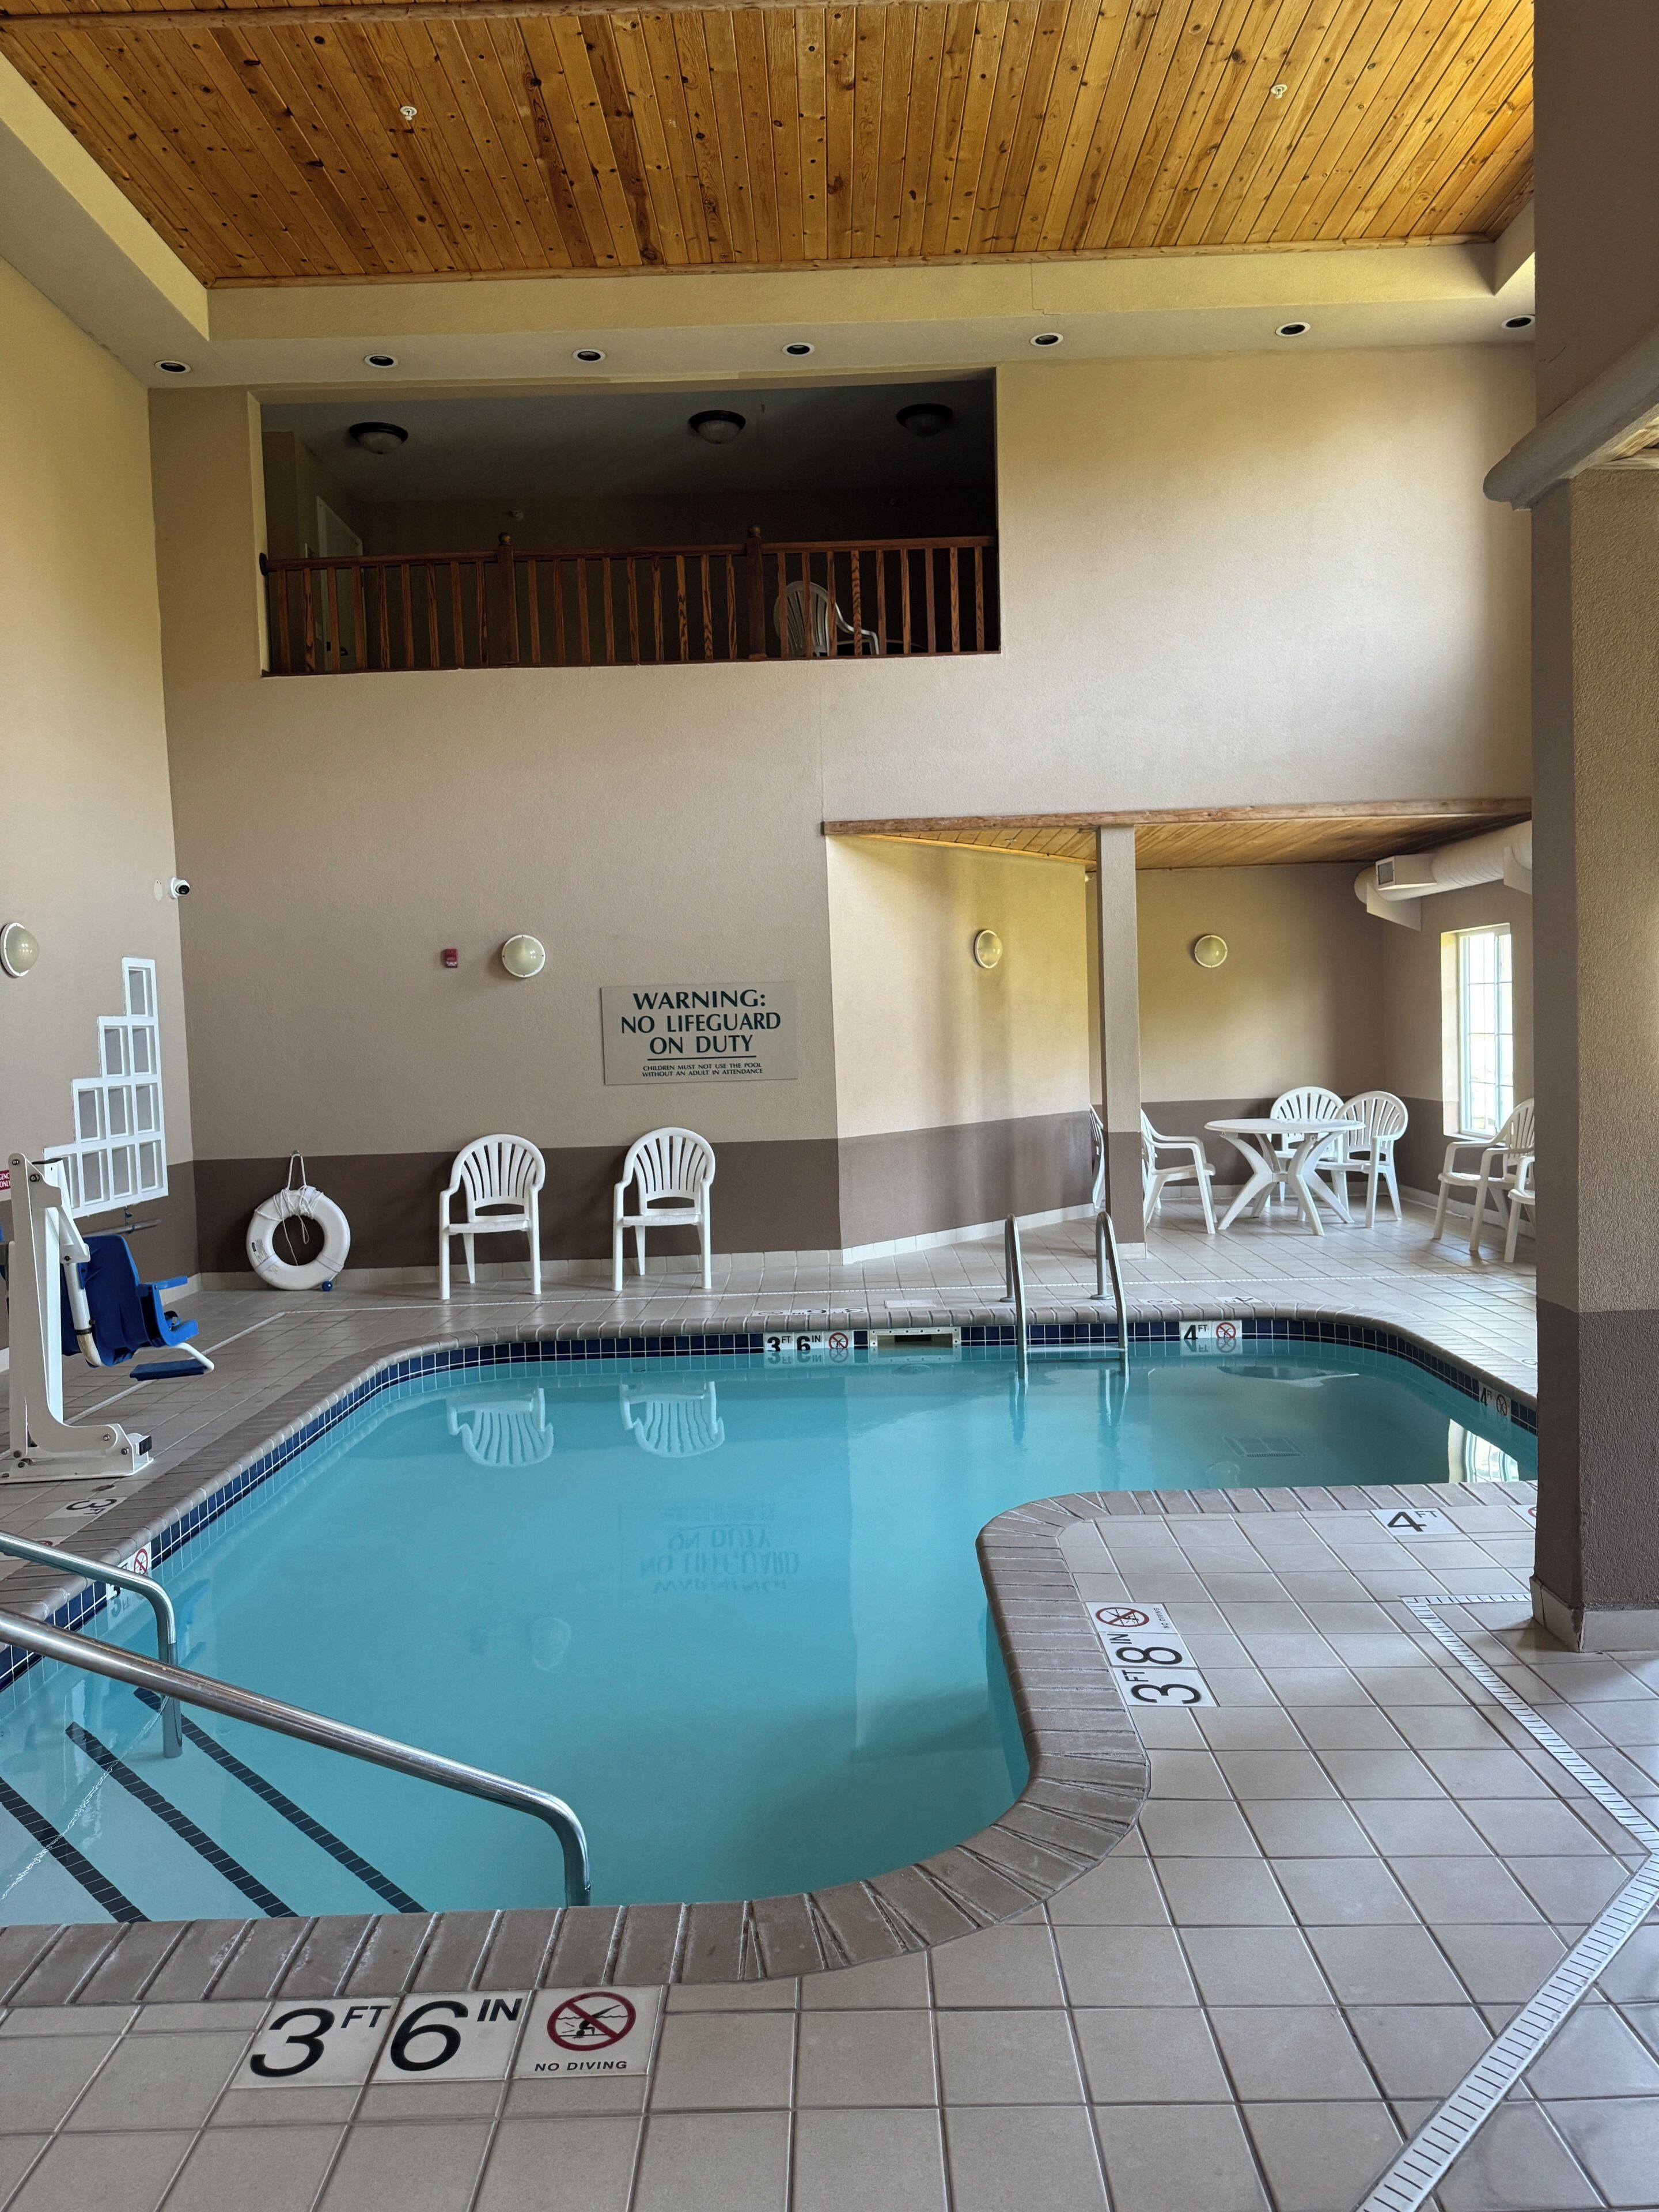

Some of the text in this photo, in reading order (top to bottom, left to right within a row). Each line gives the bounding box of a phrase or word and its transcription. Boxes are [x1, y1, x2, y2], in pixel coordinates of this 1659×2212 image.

[632, 989, 766, 1010] WARNING:
[621, 1012, 781, 1033] NO LIFEGUARD
[649, 1035, 753, 1054] ON DUTY
[1183, 1324, 1208, 1340] 4 FT
[767, 1335, 821, 1352] 3 FT 6 IN
[1480, 1387, 1493, 1406] 4 FT
[1387, 1510, 1440, 1532] 4 FT
[1153, 1608, 1166, 1622] DIVING
[1107, 1633, 1202, 1705] 3 FT 8 IN
[250, 1998, 523, 2078] 3 FT 6 IN
[534, 2060, 628, 2072] NO DIVING
